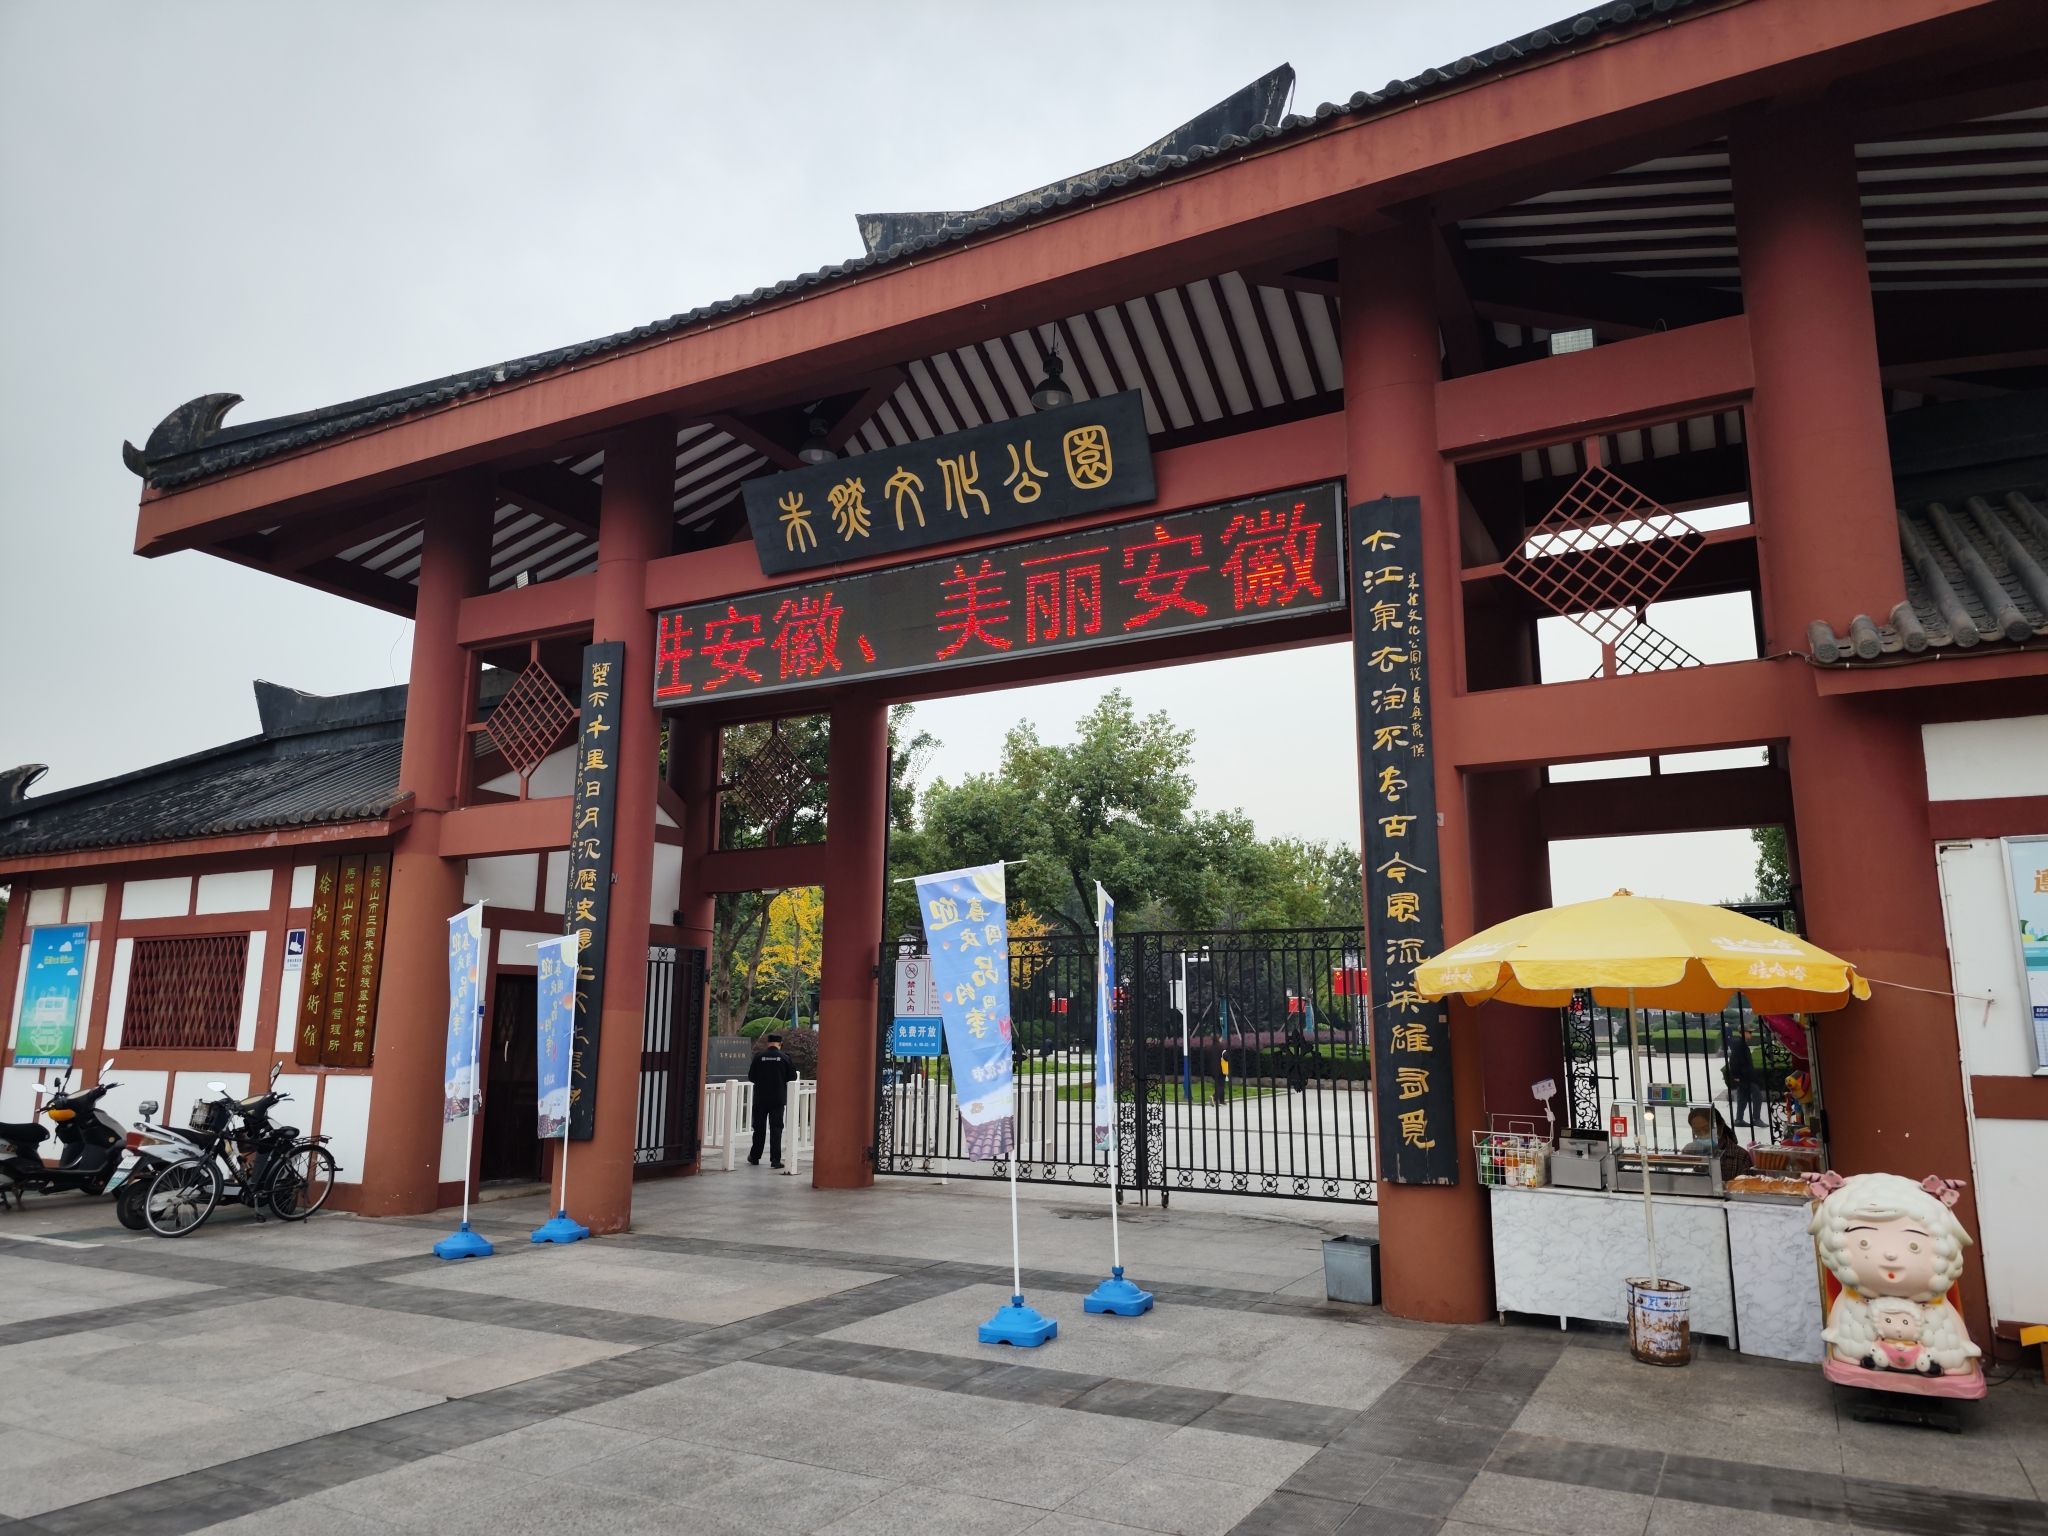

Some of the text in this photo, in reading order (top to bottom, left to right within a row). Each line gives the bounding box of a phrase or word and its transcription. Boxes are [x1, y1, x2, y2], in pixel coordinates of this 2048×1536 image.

[935, 502, 1323, 661] 美丽安徽
[906, 981, 916, 1012] 禁止入内
[899, 1025, 936, 1038] 免费开放
